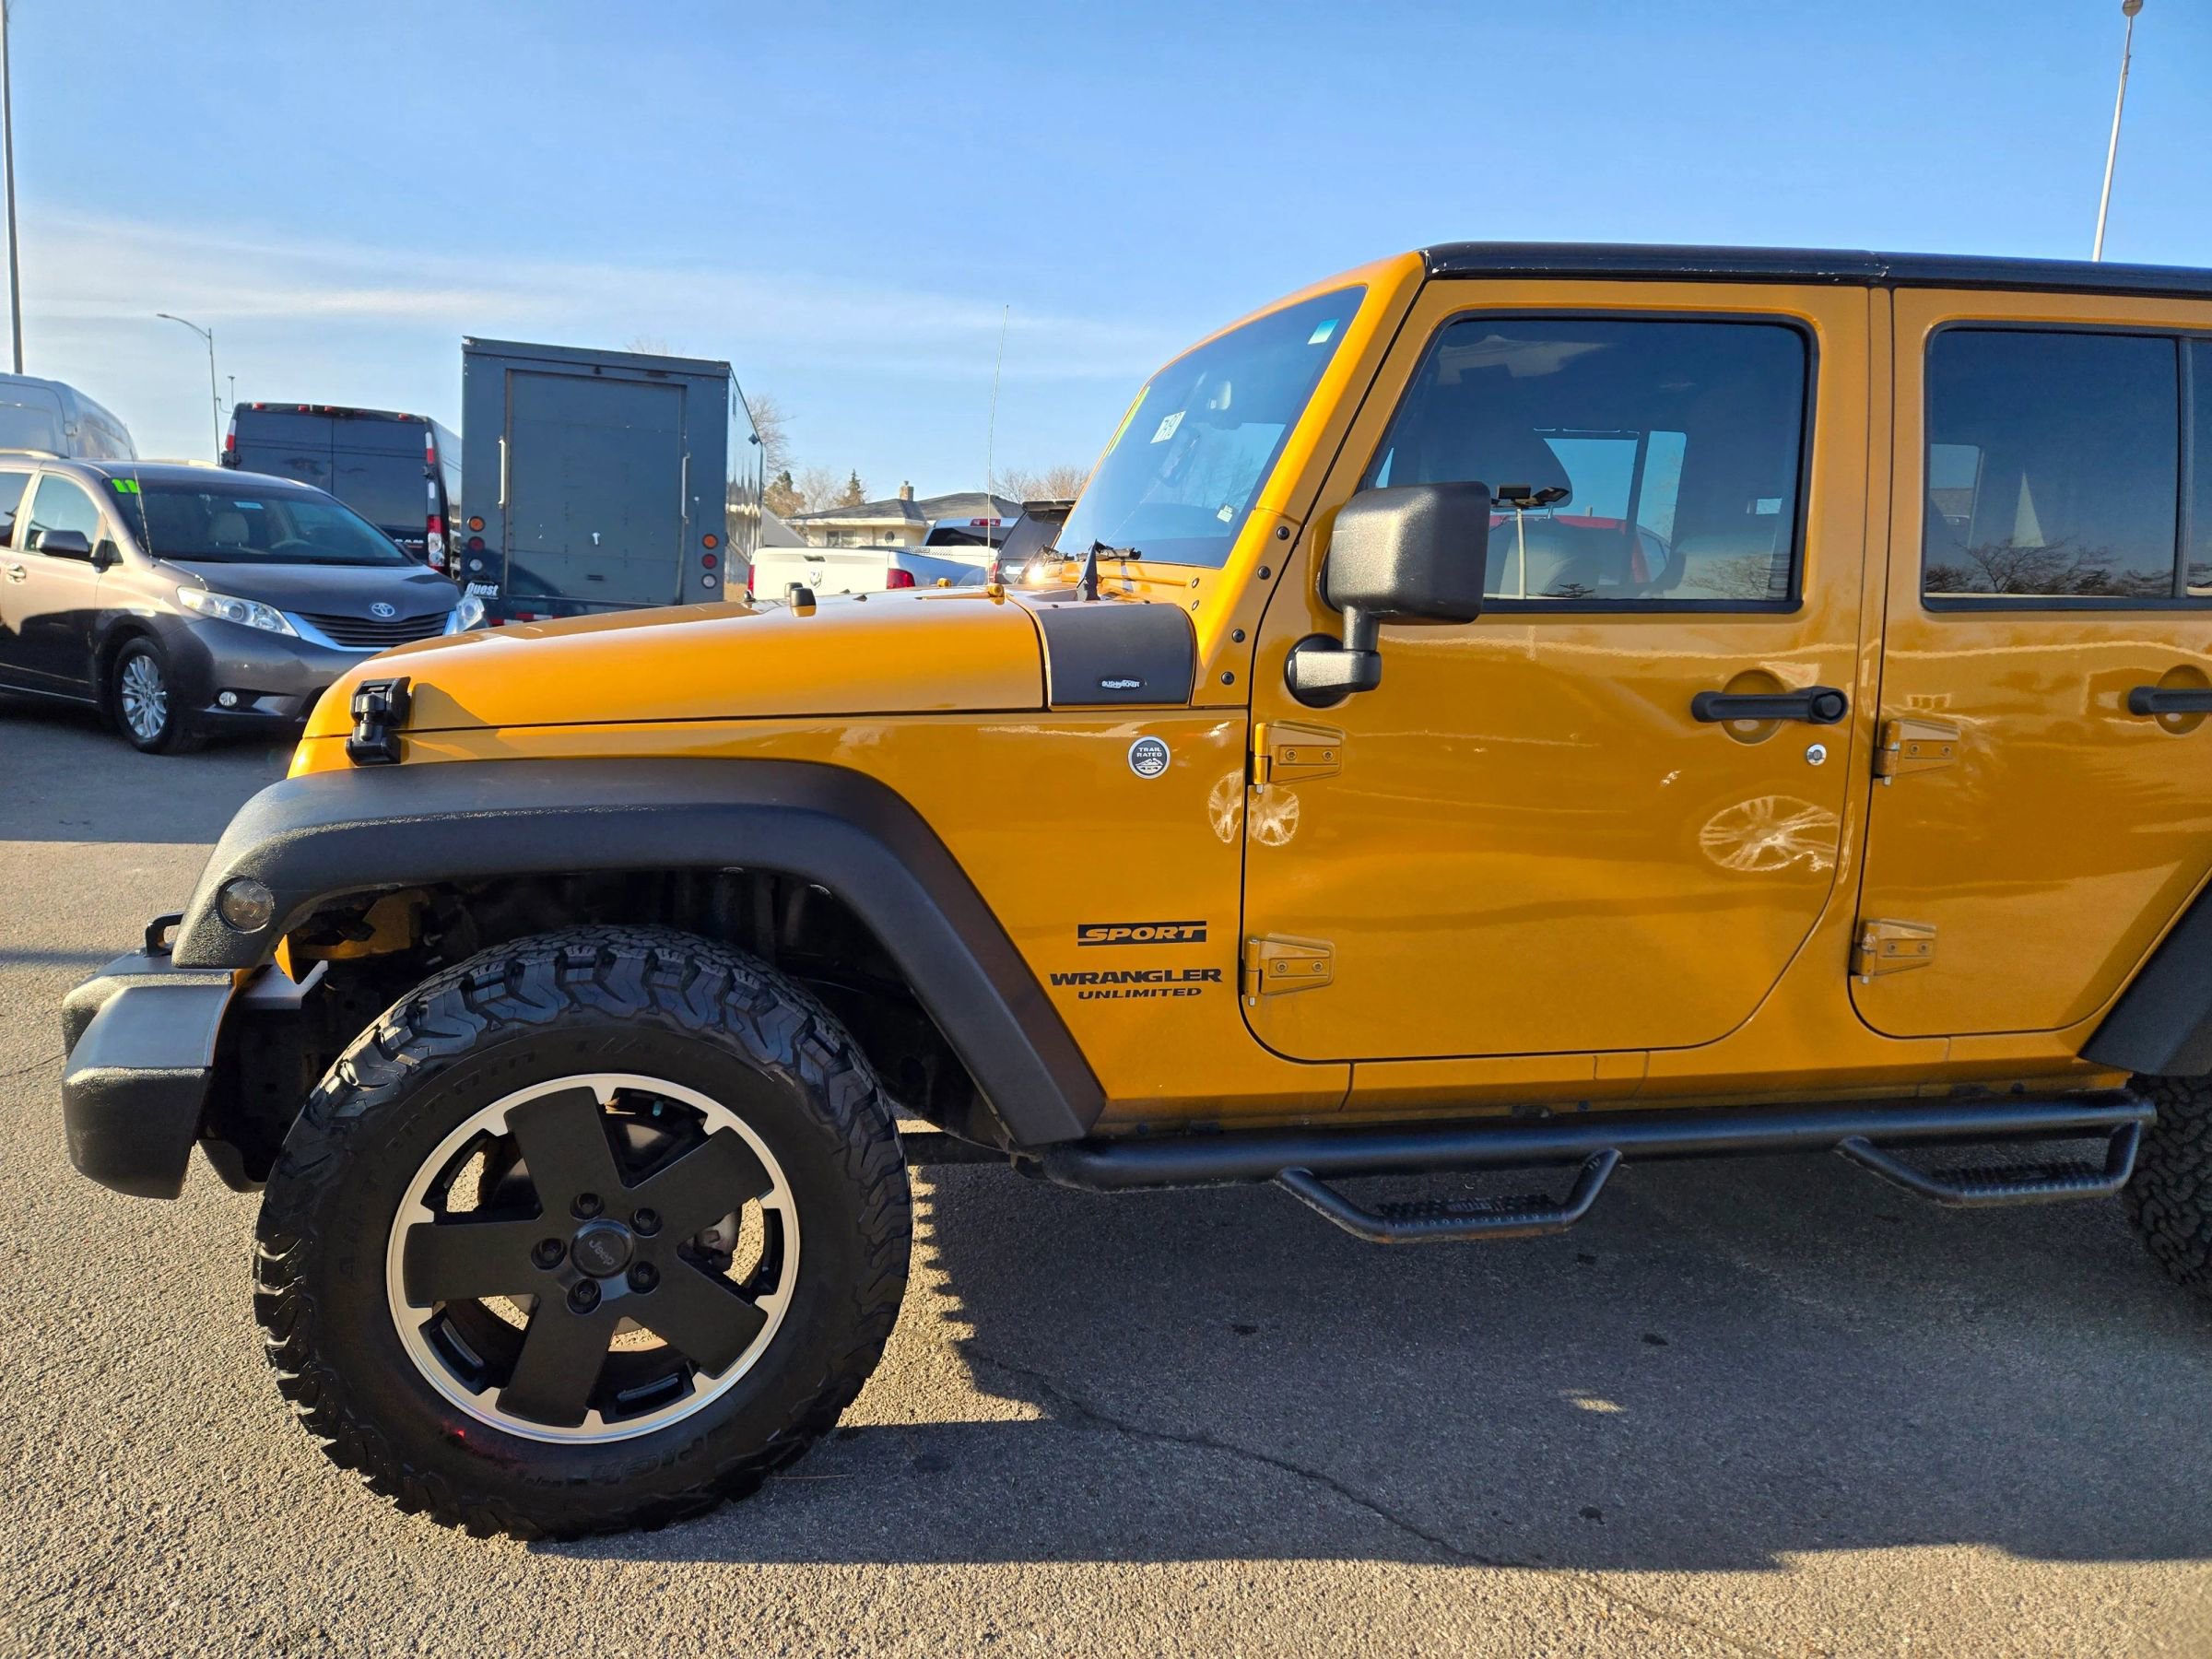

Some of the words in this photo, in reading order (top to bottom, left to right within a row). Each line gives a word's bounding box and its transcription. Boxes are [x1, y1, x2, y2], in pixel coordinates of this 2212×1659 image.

[112, 478, 141, 494] 11
[465, 582, 499, 597] Quest
[1077, 924, 1206, 943] SPORT
[1050, 968, 1223, 986] WRANGLER
[1077, 987, 1202, 1000] UNLIMITED
[588, 1240, 615, 1265] Jeep
